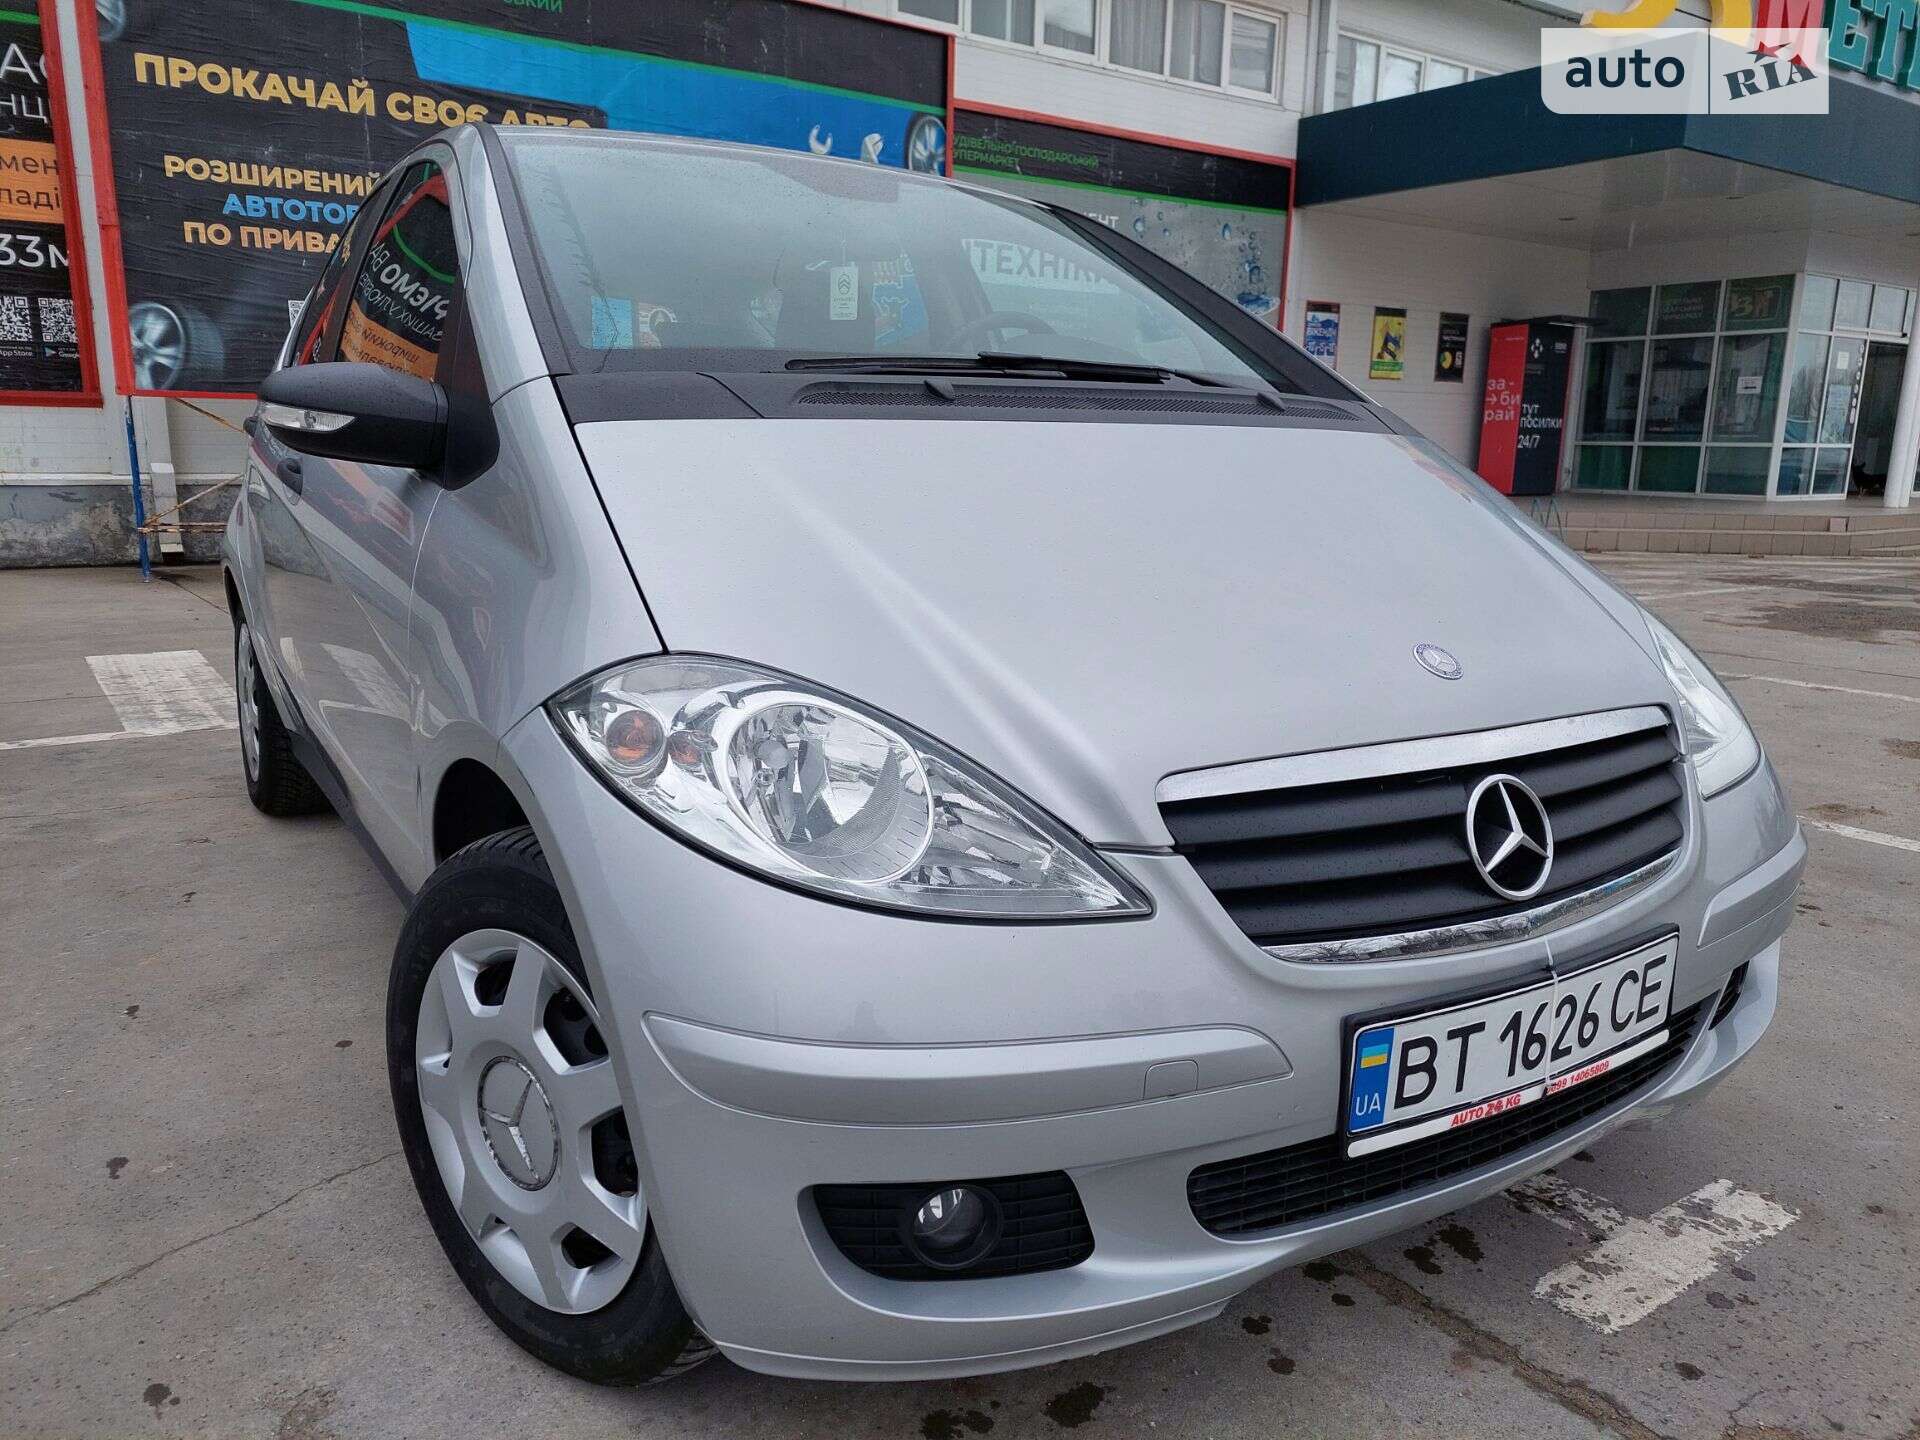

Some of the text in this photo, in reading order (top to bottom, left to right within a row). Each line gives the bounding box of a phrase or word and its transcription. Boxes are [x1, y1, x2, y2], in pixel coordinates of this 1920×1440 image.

[133, 52, 376, 117] ПРОКАЧАЙ
[183, 221, 231, 246] ПО
[1393, 954, 1668, 1110] BT 1626 CE
[1355, 1091, 1382, 1117] UA
[1451, 1107, 1484, 1127] AUTO
